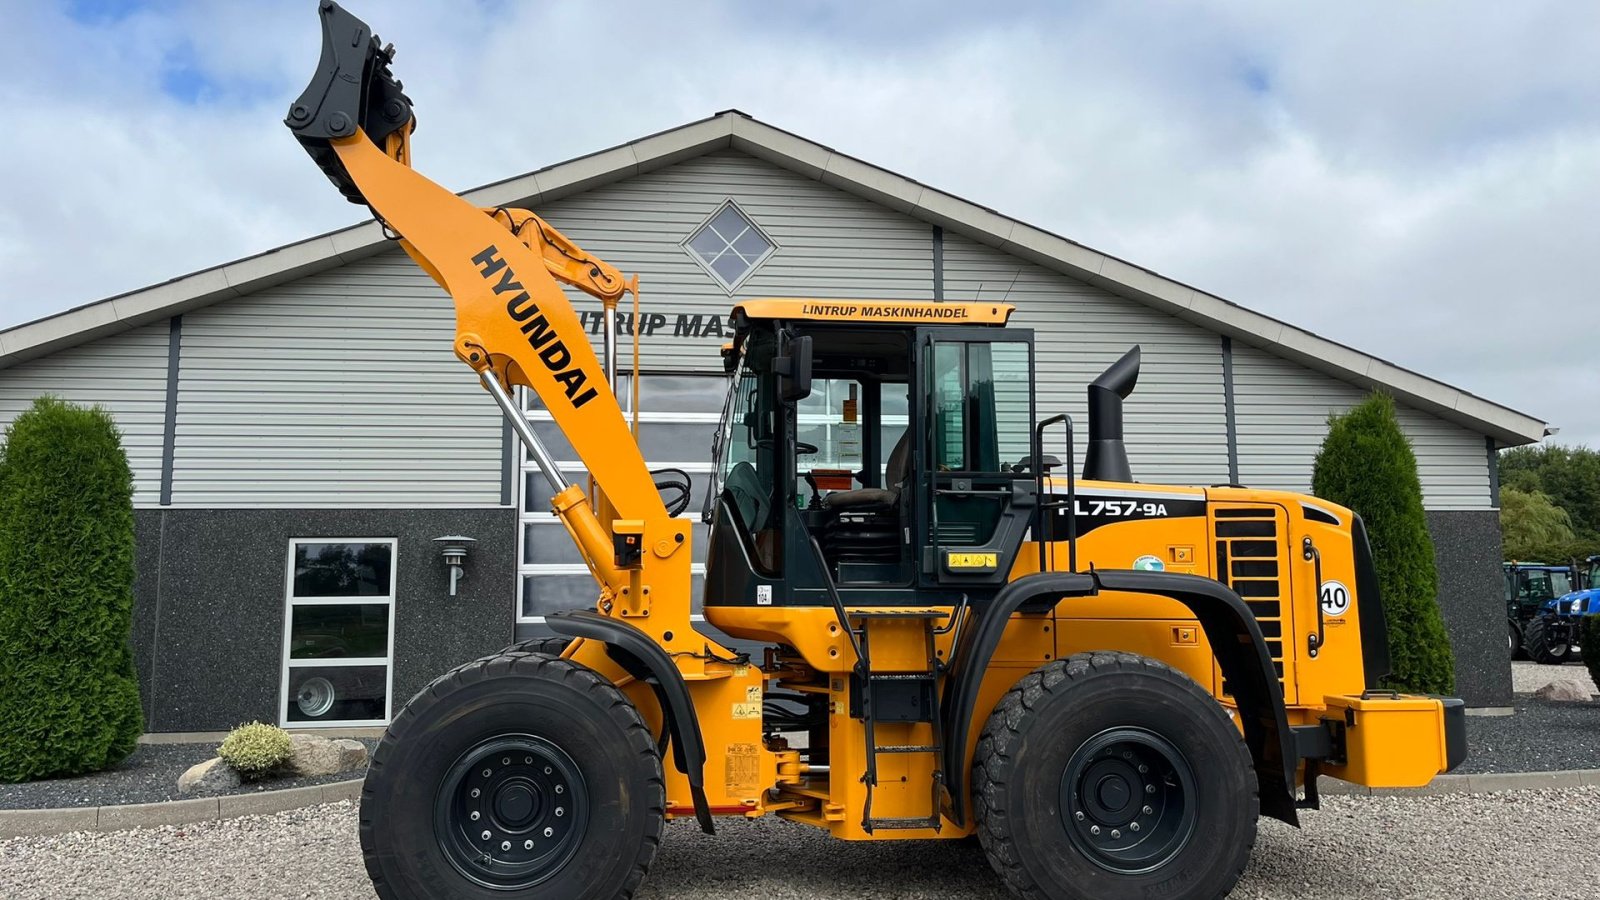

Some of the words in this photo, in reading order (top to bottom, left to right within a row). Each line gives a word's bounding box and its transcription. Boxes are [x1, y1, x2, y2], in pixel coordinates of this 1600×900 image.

[802, 304, 857, 316] LINTRUP
[861, 306, 969, 318] MASKINHANDEL
[471, 244, 599, 409] HYUNDAI
[1321, 587, 1346, 609] 40
